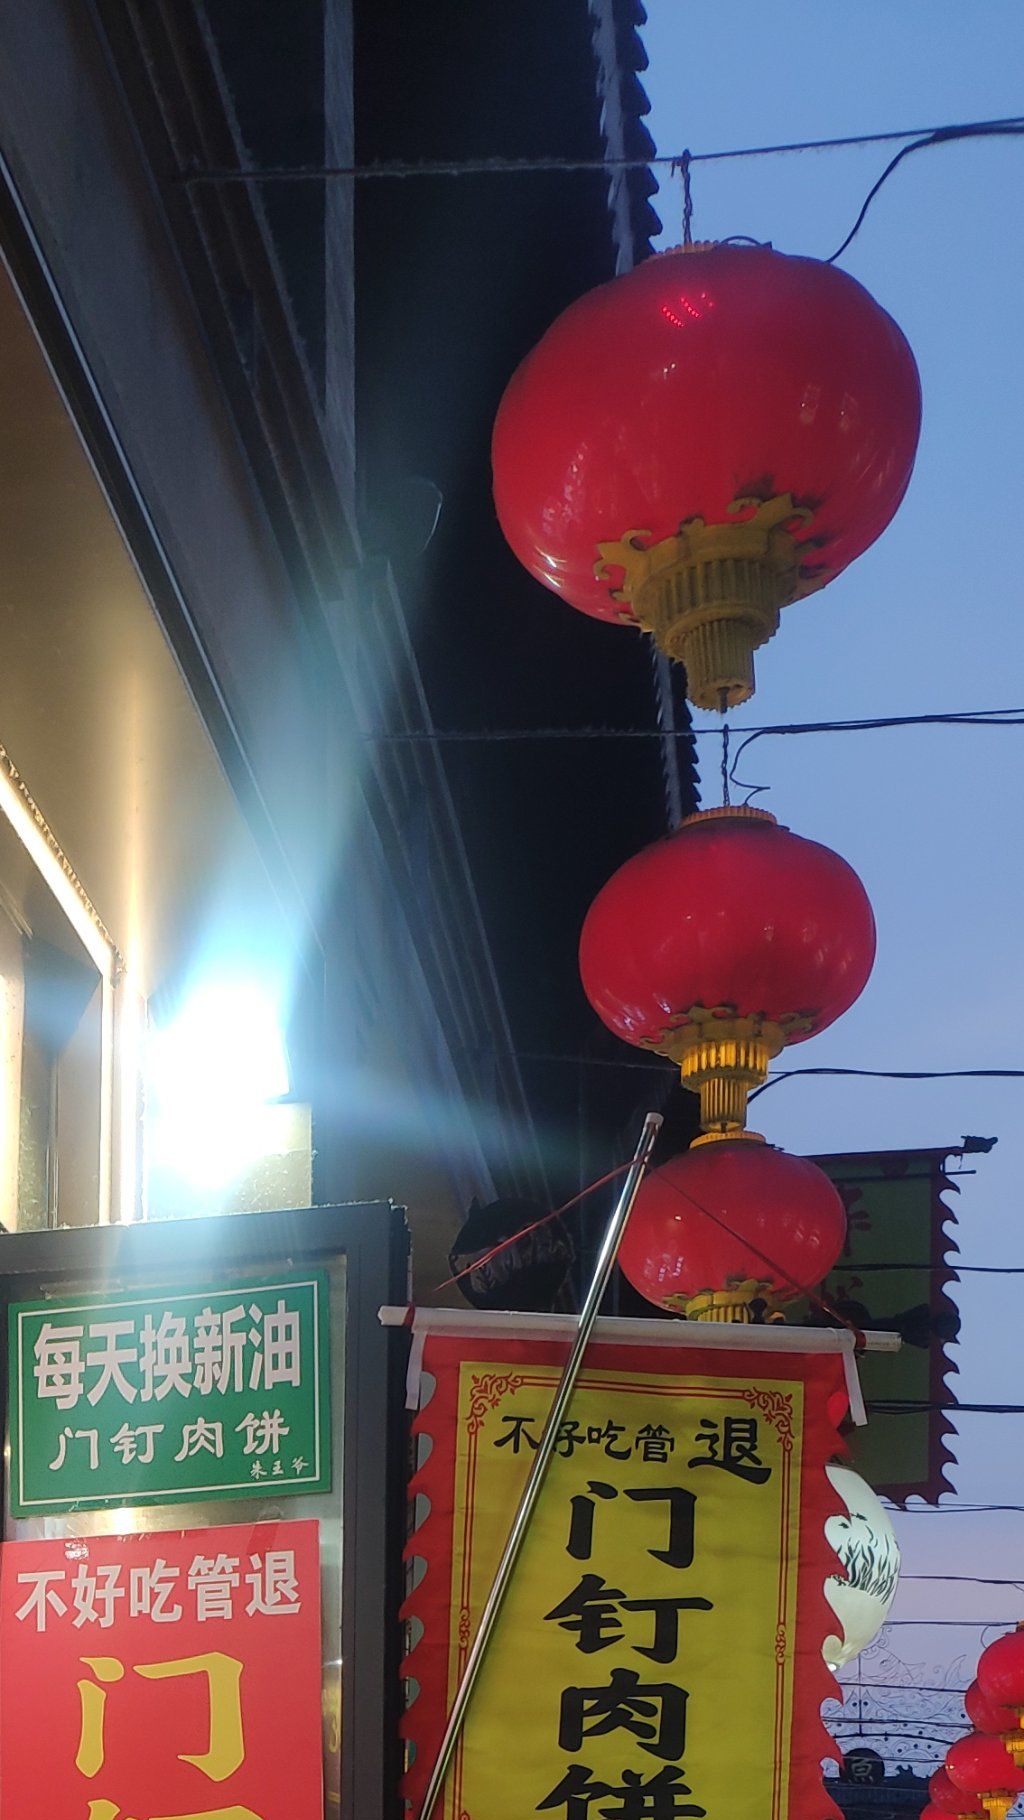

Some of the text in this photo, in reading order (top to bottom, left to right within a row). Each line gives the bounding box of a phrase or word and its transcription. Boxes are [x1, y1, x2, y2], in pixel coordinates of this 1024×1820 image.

[34, 1300, 302, 1411] 每天换新油
[49, 1410, 290, 1471] 门钉肉饼
[493, 1415, 772, 1486] 不好吃管退
[15, 1550, 302, 1633] 不好吃管退
